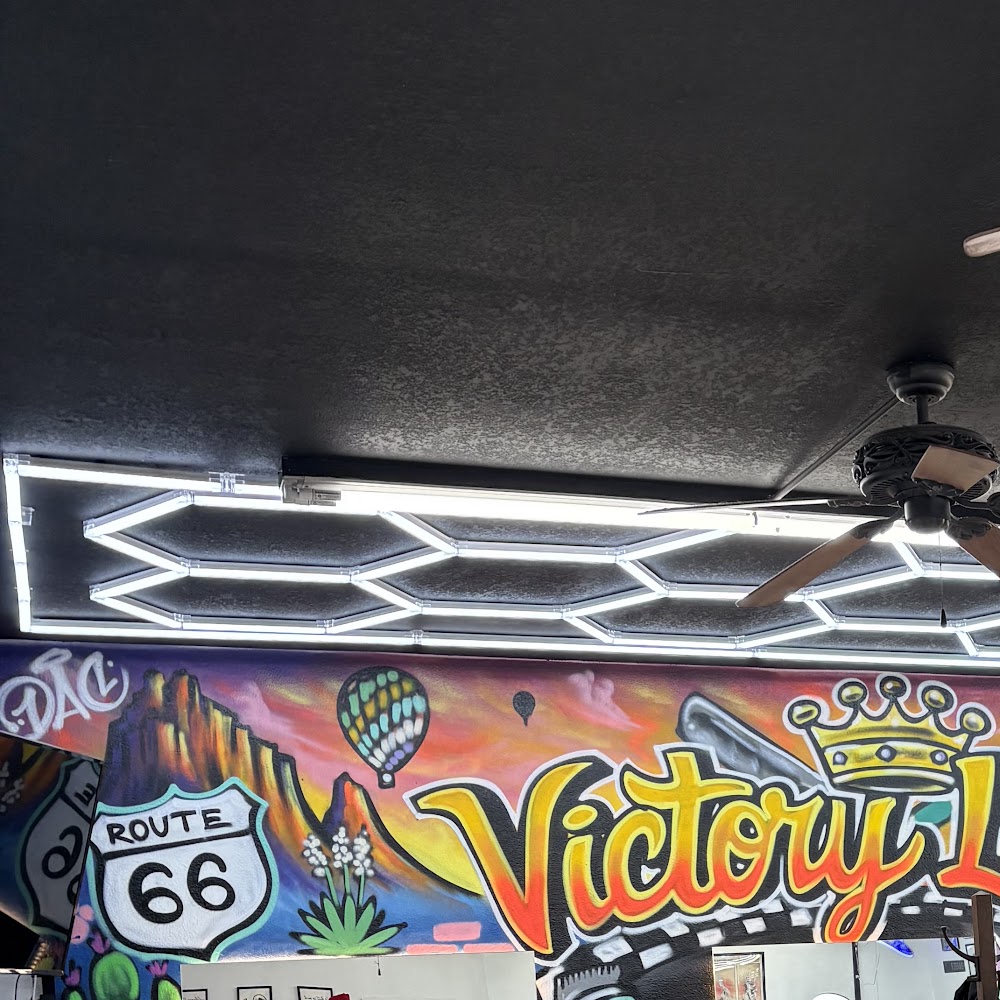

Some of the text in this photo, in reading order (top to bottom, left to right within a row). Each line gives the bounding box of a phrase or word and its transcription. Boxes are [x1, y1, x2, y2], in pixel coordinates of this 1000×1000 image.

[107, 808, 232, 846] ROUTE
[418, 748, 926, 953] Victory
[129, 852, 237, 924] 66
